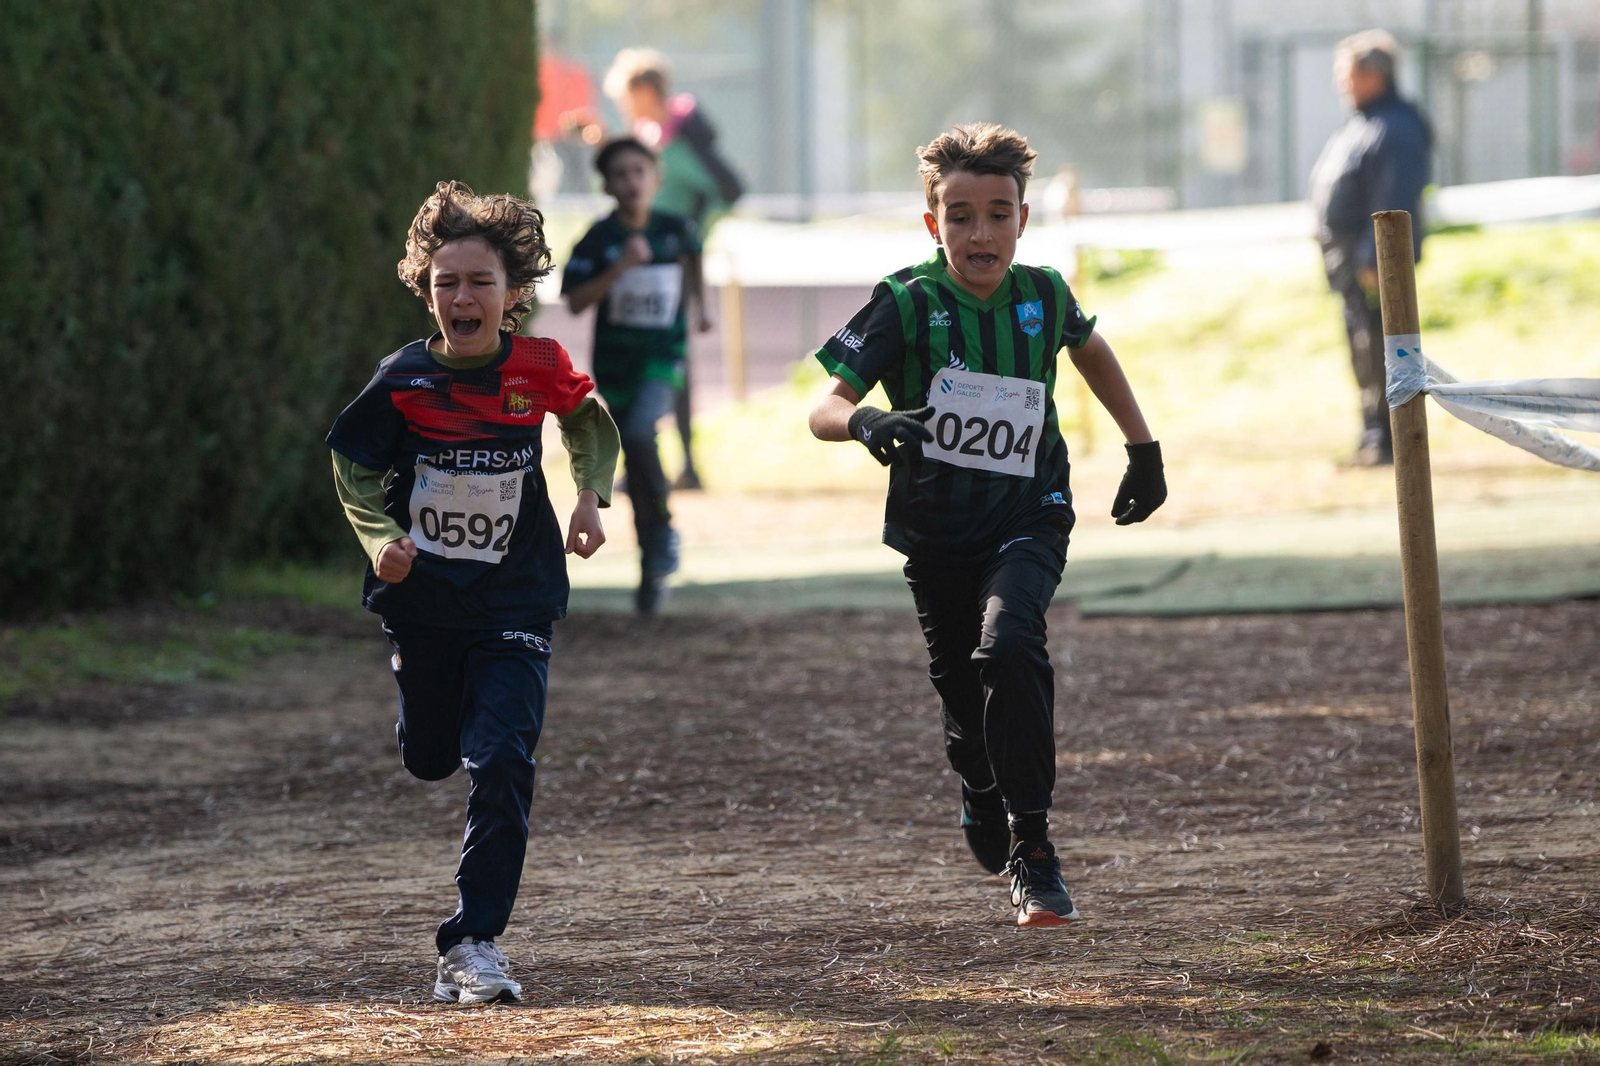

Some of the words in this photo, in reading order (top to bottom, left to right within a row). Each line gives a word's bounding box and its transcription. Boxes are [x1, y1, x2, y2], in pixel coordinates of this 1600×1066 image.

[957, 382, 985, 392] DEPORTE
[956, 389, 982, 399] GALEGO
[936, 412, 1034, 463] 0204
[430, 488, 454, 496] GALEGO
[419, 506, 514, 552] 0592
